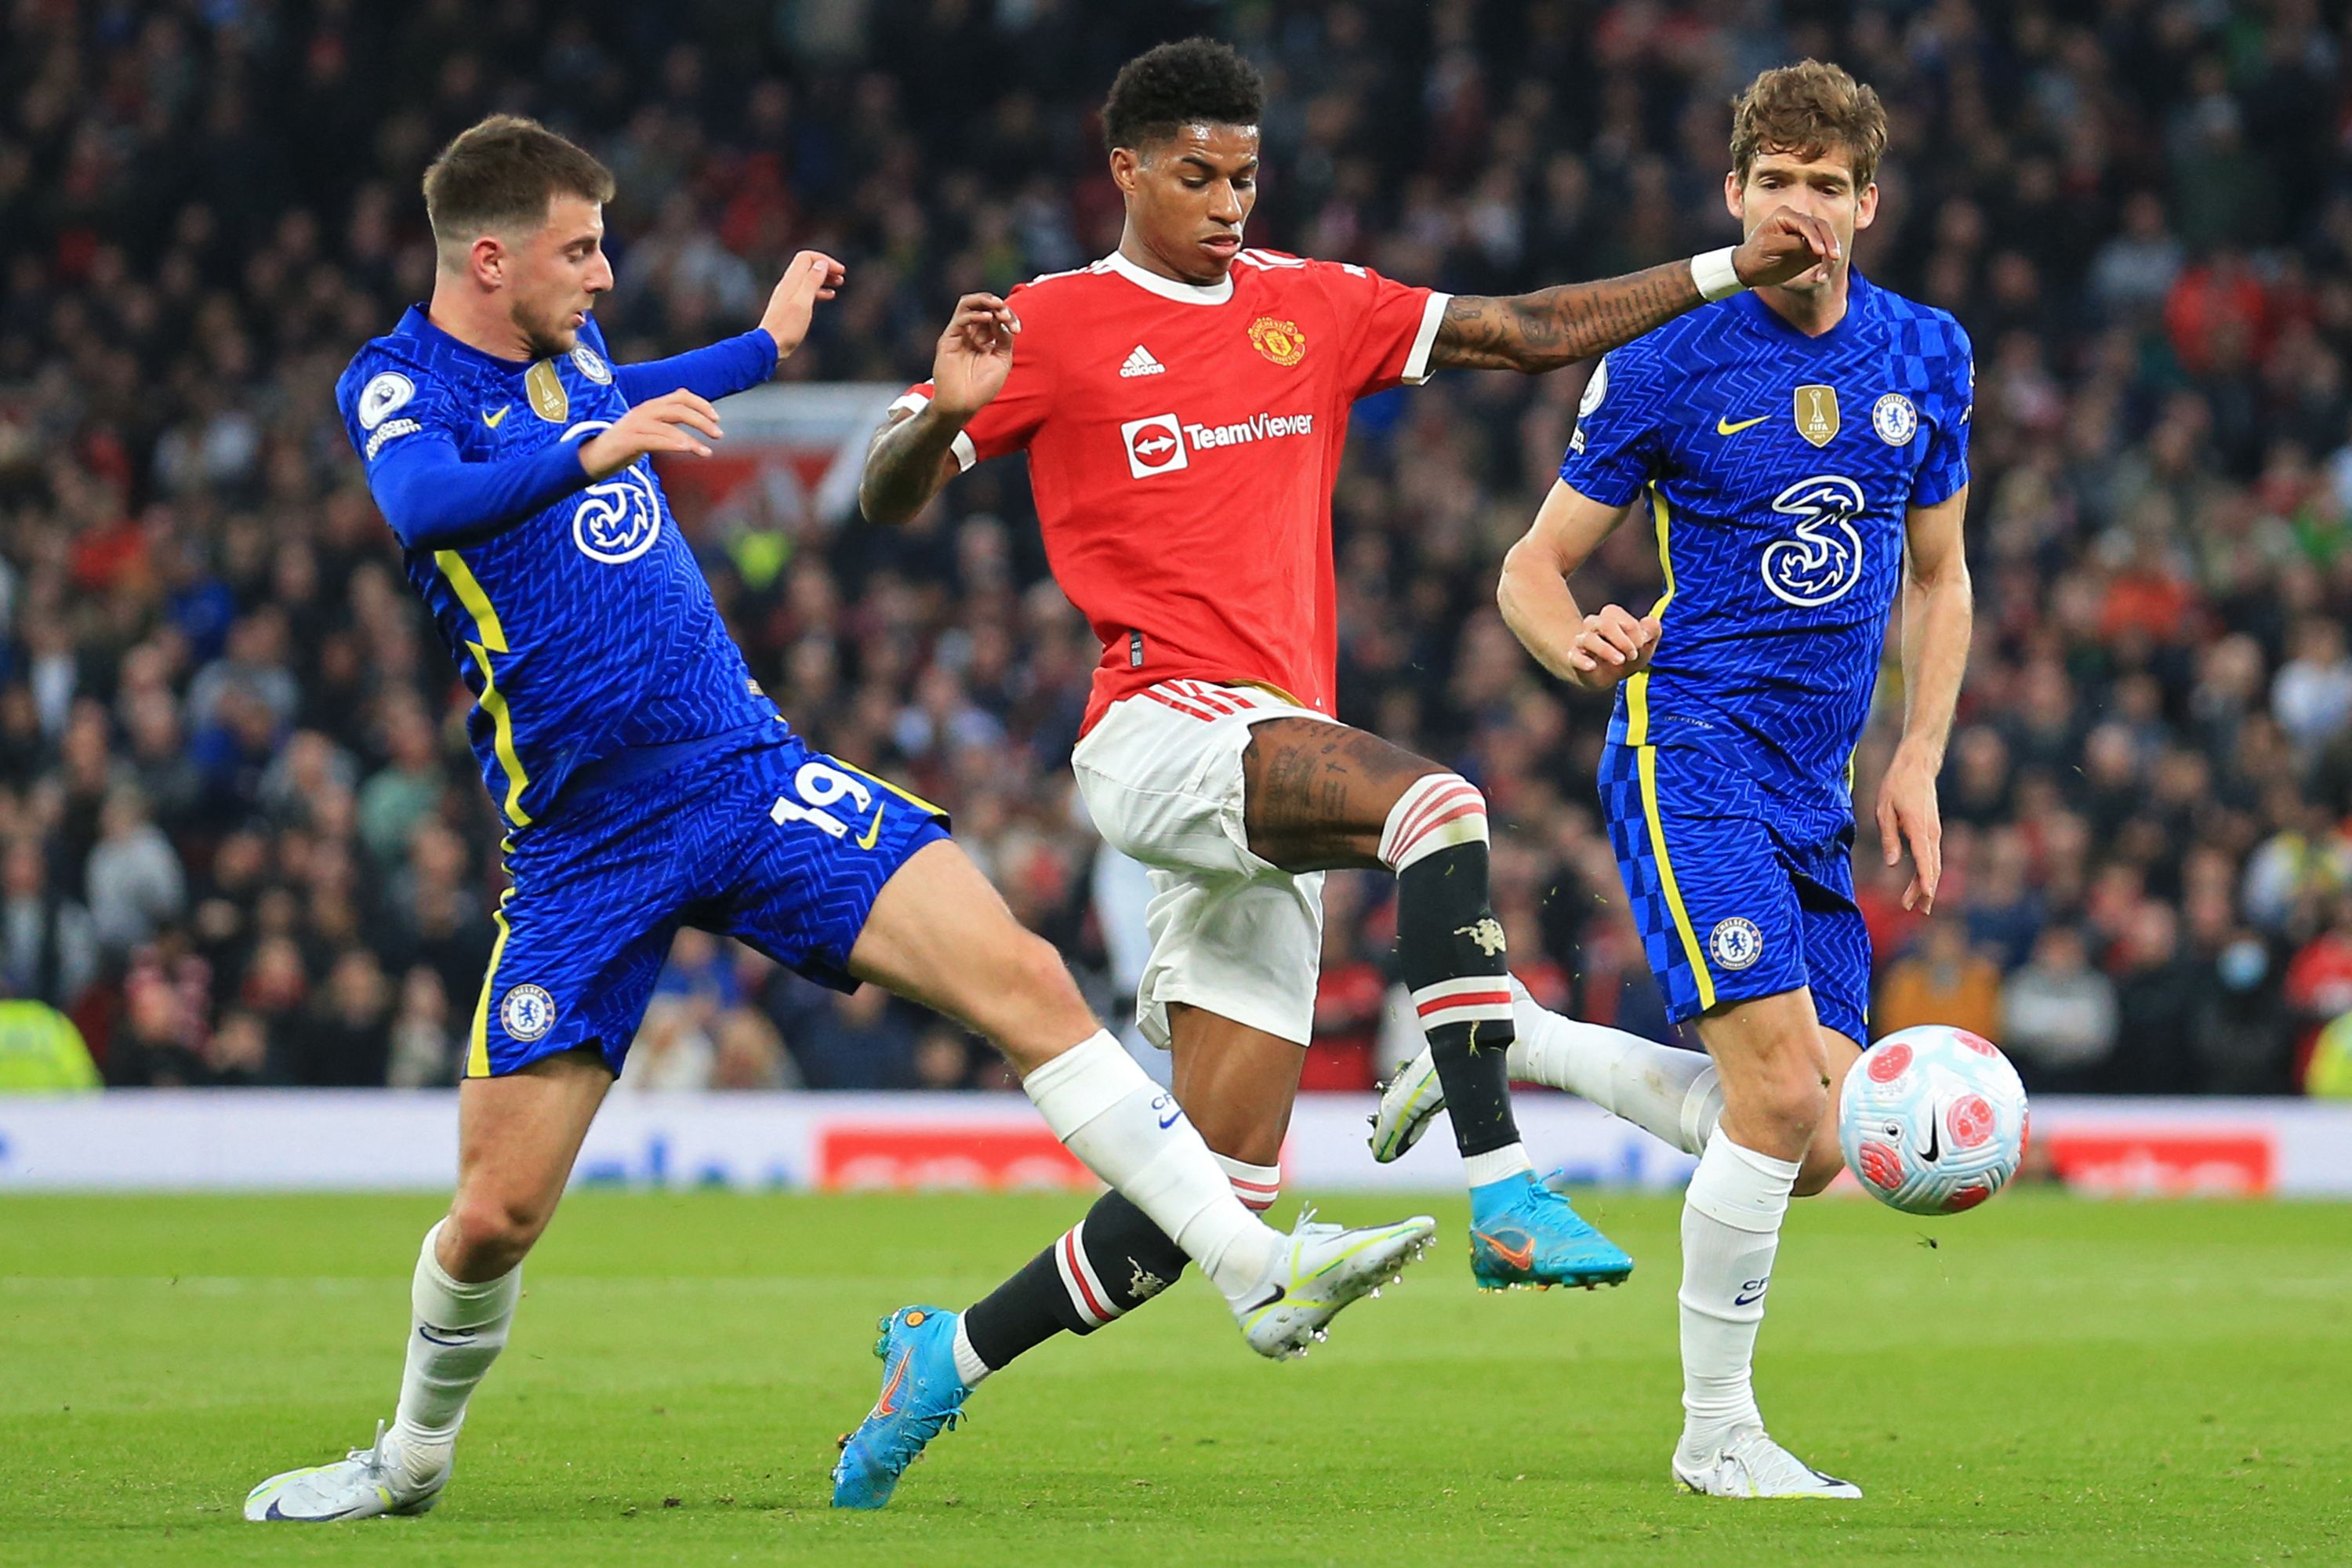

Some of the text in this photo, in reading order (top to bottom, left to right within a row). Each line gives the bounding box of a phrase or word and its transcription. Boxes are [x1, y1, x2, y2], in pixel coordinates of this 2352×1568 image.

[1120, 363, 1166, 378] adidas
[1183, 412, 1313, 451] TeamViewer
[1809, 423, 1829, 431] FIFA
[1761, 475, 1864, 608] 3
[769, 761, 873, 840] 19
